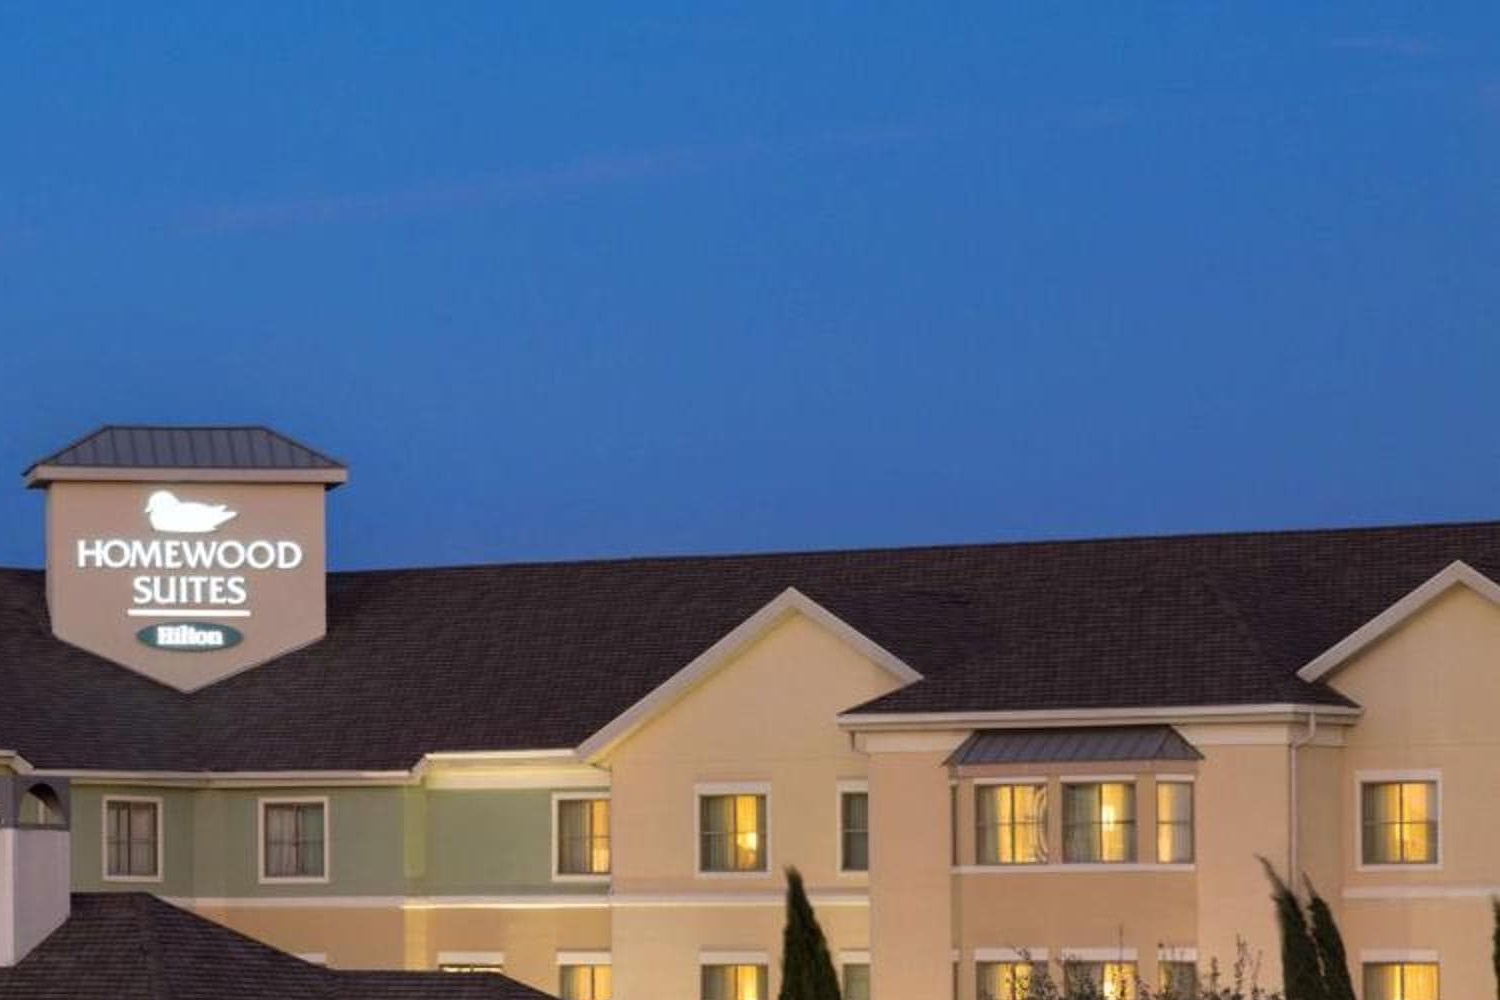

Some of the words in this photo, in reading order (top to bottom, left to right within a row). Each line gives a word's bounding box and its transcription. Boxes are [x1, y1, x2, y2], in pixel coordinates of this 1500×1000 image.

[77, 540, 302, 569] HOMEWOOD
[133, 576, 247, 604] SUITES
[156, 625, 223, 646] Hilton
